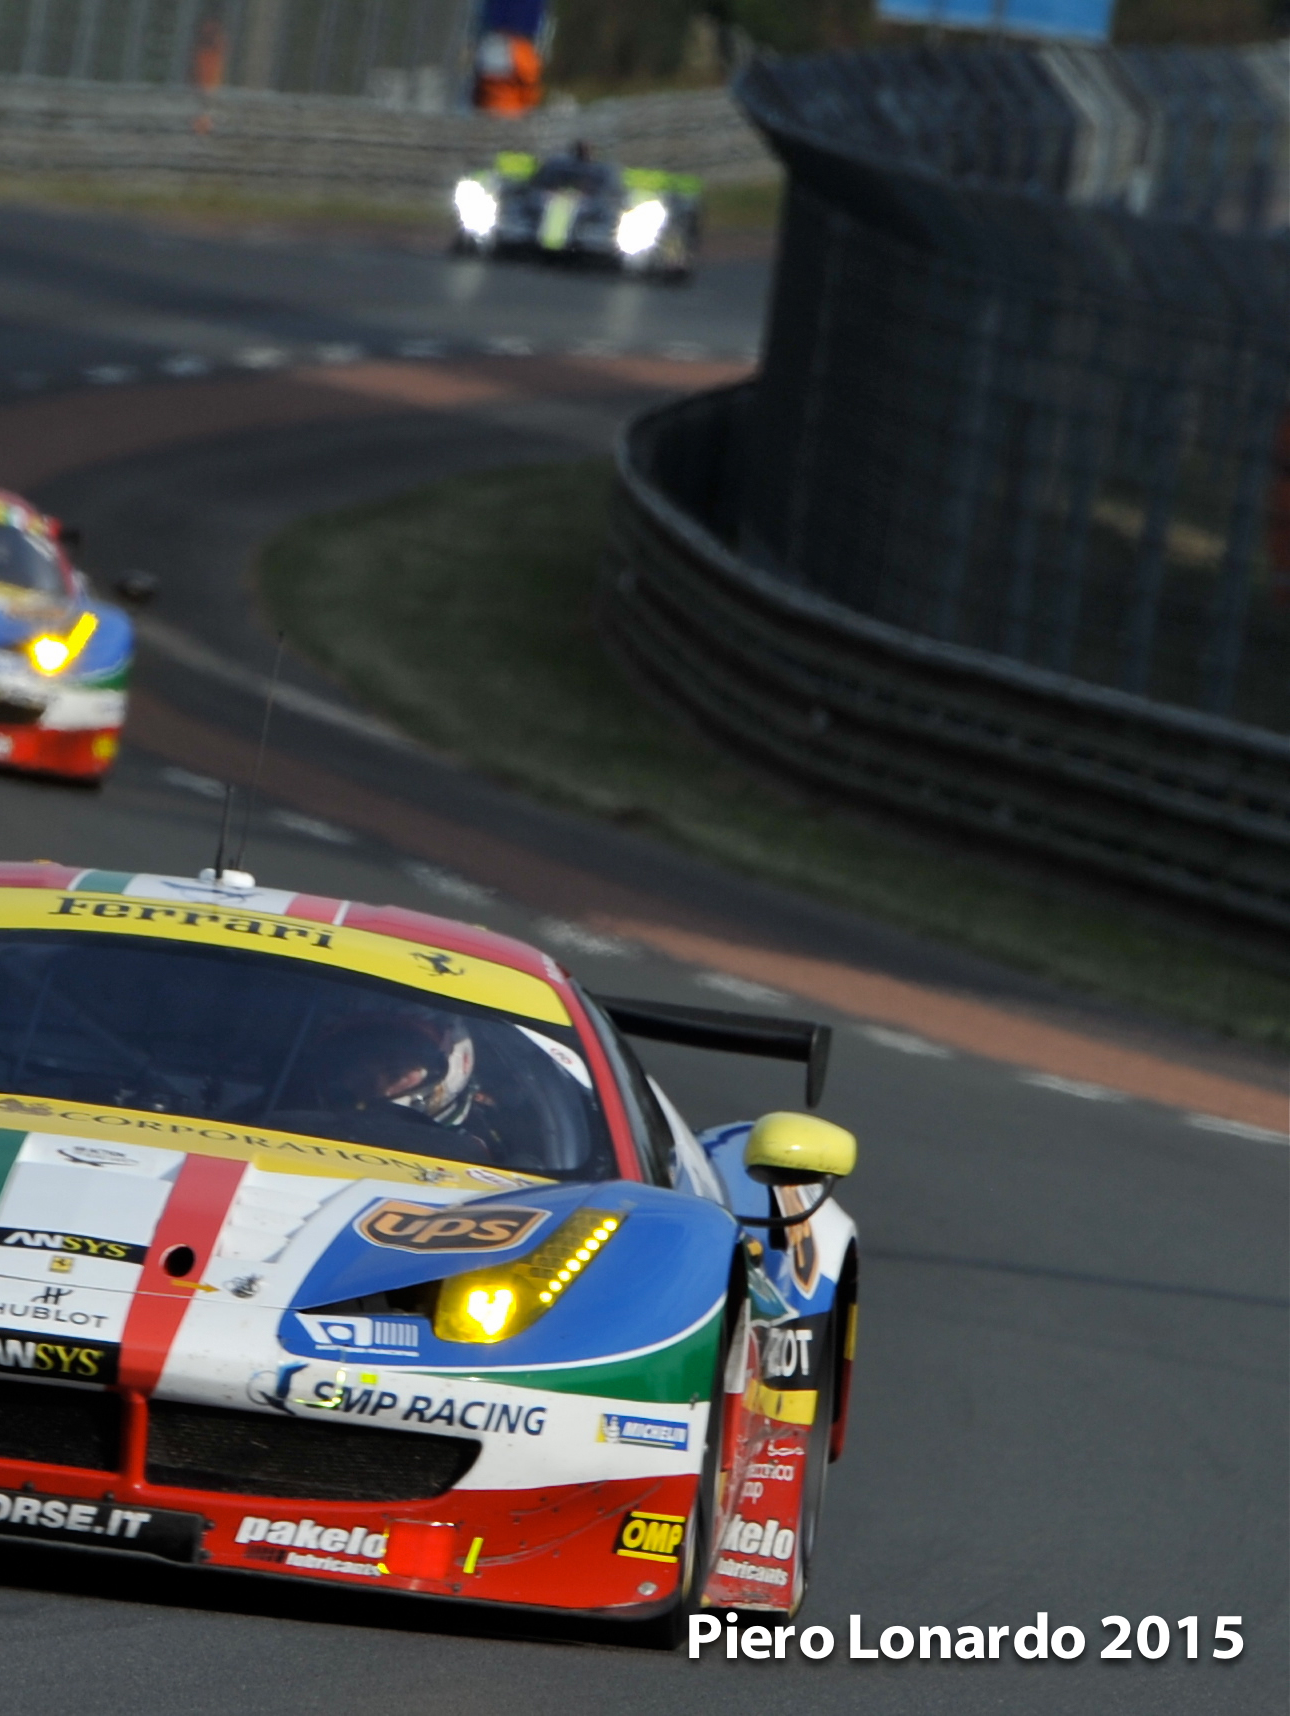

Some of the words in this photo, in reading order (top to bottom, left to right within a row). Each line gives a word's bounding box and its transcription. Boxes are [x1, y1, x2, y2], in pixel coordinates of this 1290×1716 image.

[48, 895, 334, 950] Ferrari
[59, 1111, 427, 1173] CORPORATION
[3, 1231, 133, 1258] ANSYS
[372, 1212, 520, 1244] ups
[313, 1380, 398, 1417] SMP
[402, 1395, 549, 1436] RACING
[622, 1421, 688, 1443] MICHELIN
[234, 1515, 387, 1559] pakelo
[621, 1518, 683, 1555] OMP
